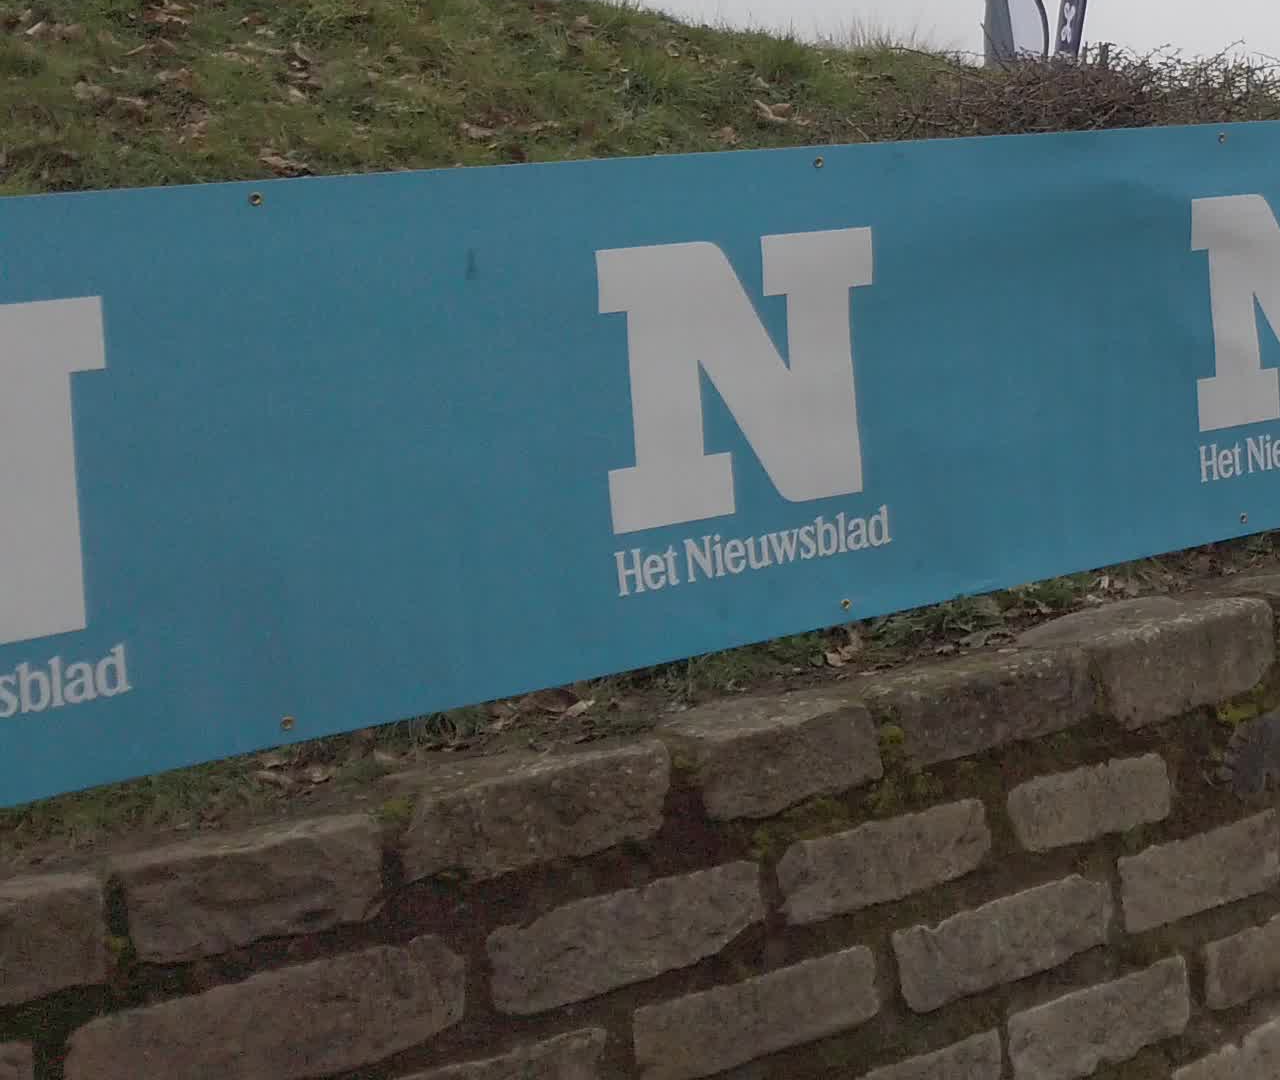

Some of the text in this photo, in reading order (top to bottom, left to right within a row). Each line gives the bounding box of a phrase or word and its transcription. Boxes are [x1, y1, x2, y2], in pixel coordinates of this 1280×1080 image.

[595, 226, 873, 534] N
[1199, 442, 1243, 483] Het
[614, 504, 893, 597] Het Nieuwsblad
